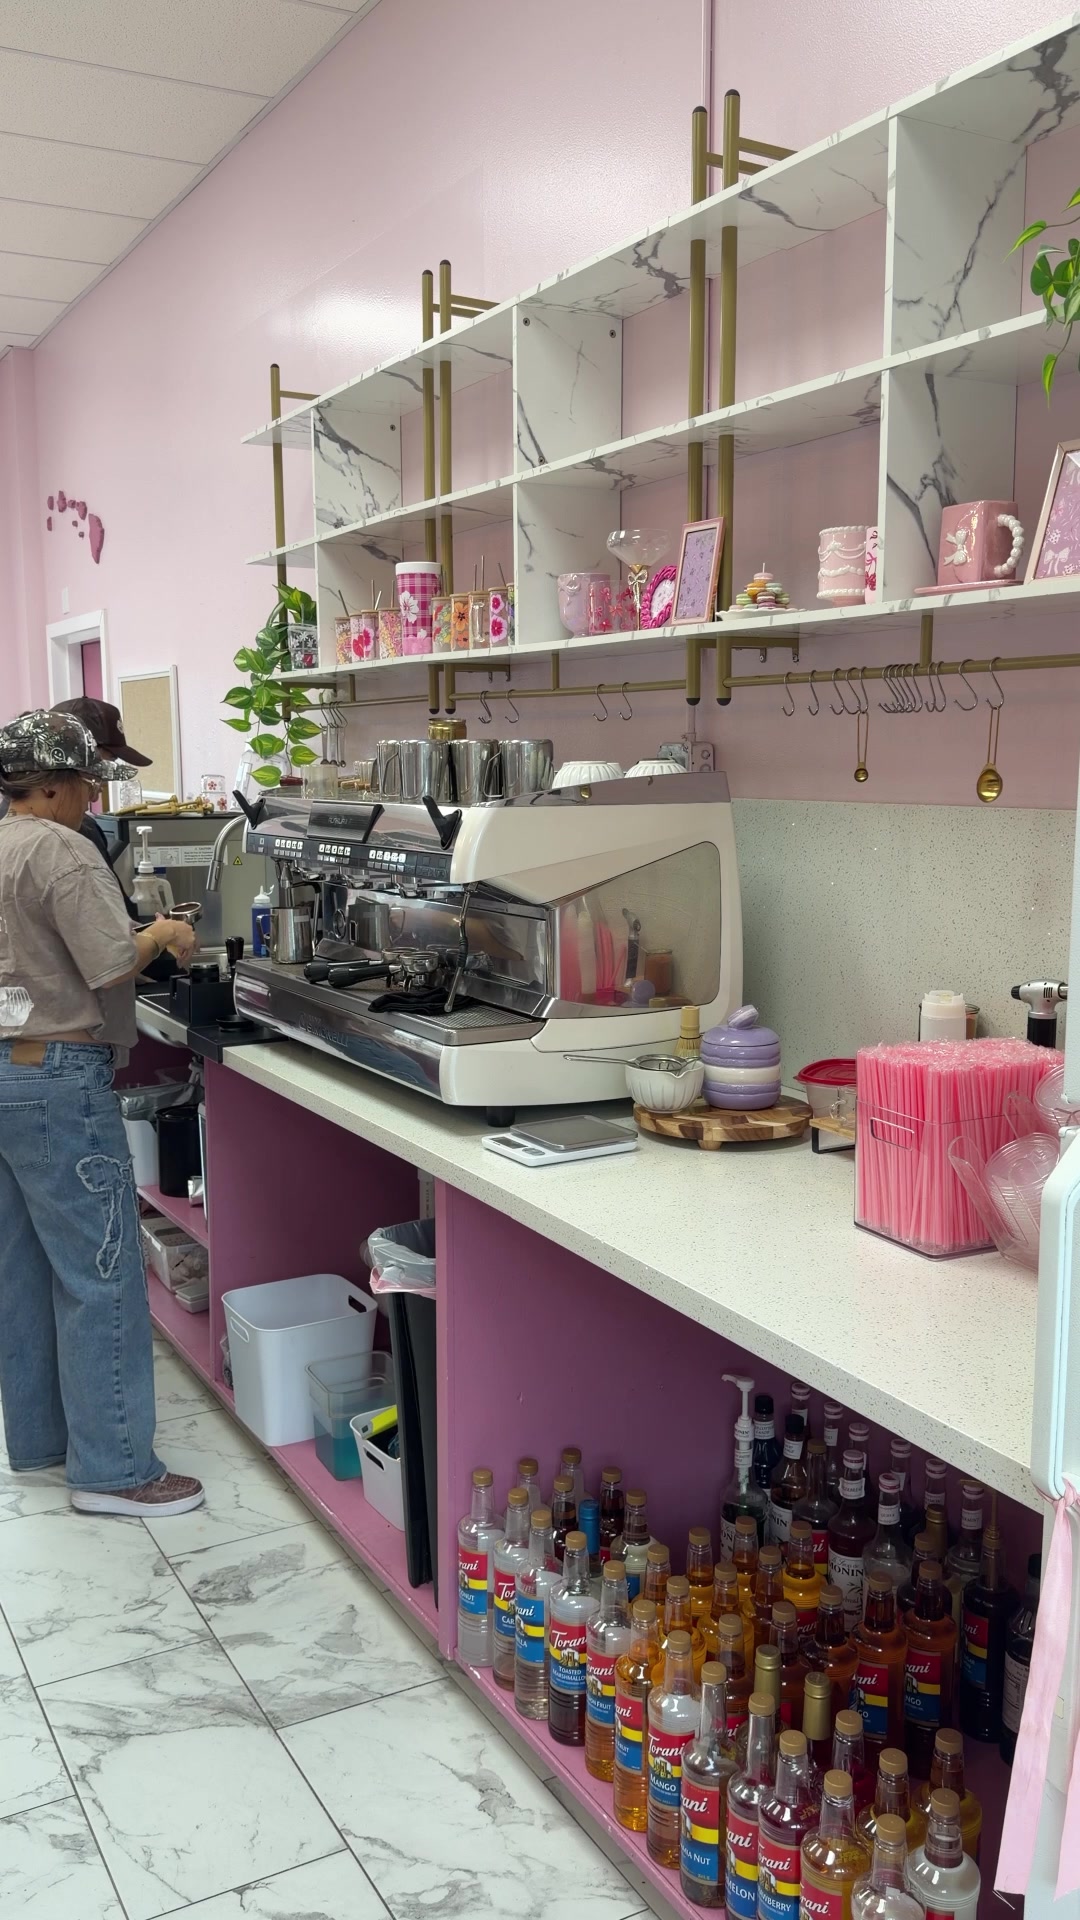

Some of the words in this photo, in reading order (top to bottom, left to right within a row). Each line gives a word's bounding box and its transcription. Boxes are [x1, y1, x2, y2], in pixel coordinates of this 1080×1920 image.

[458, 1559, 479, 1570] rani
[498, 1582, 516, 1600] Tor
[516, 1605, 535, 1616] rani
[552, 1630, 587, 1649] Toran
[552, 1668, 586, 1681] MARSHMALLO
[558, 1665, 582, 1675] TOASTED
[905, 1662, 931, 1674] rani
[596, 1700, 611, 1710] FRUIT
[905, 1694, 922, 1706] NGO
[615, 1706, 632, 1717] ani
[648, 1733, 685, 1757] Torani
[650, 1773, 677, 1792] MANGO
[681, 1797, 708, 1812] ani
[727, 1831, 753, 1848] ani
[693, 1853, 711, 1866] NUT
[728, 1880, 755, 1902] MELON
